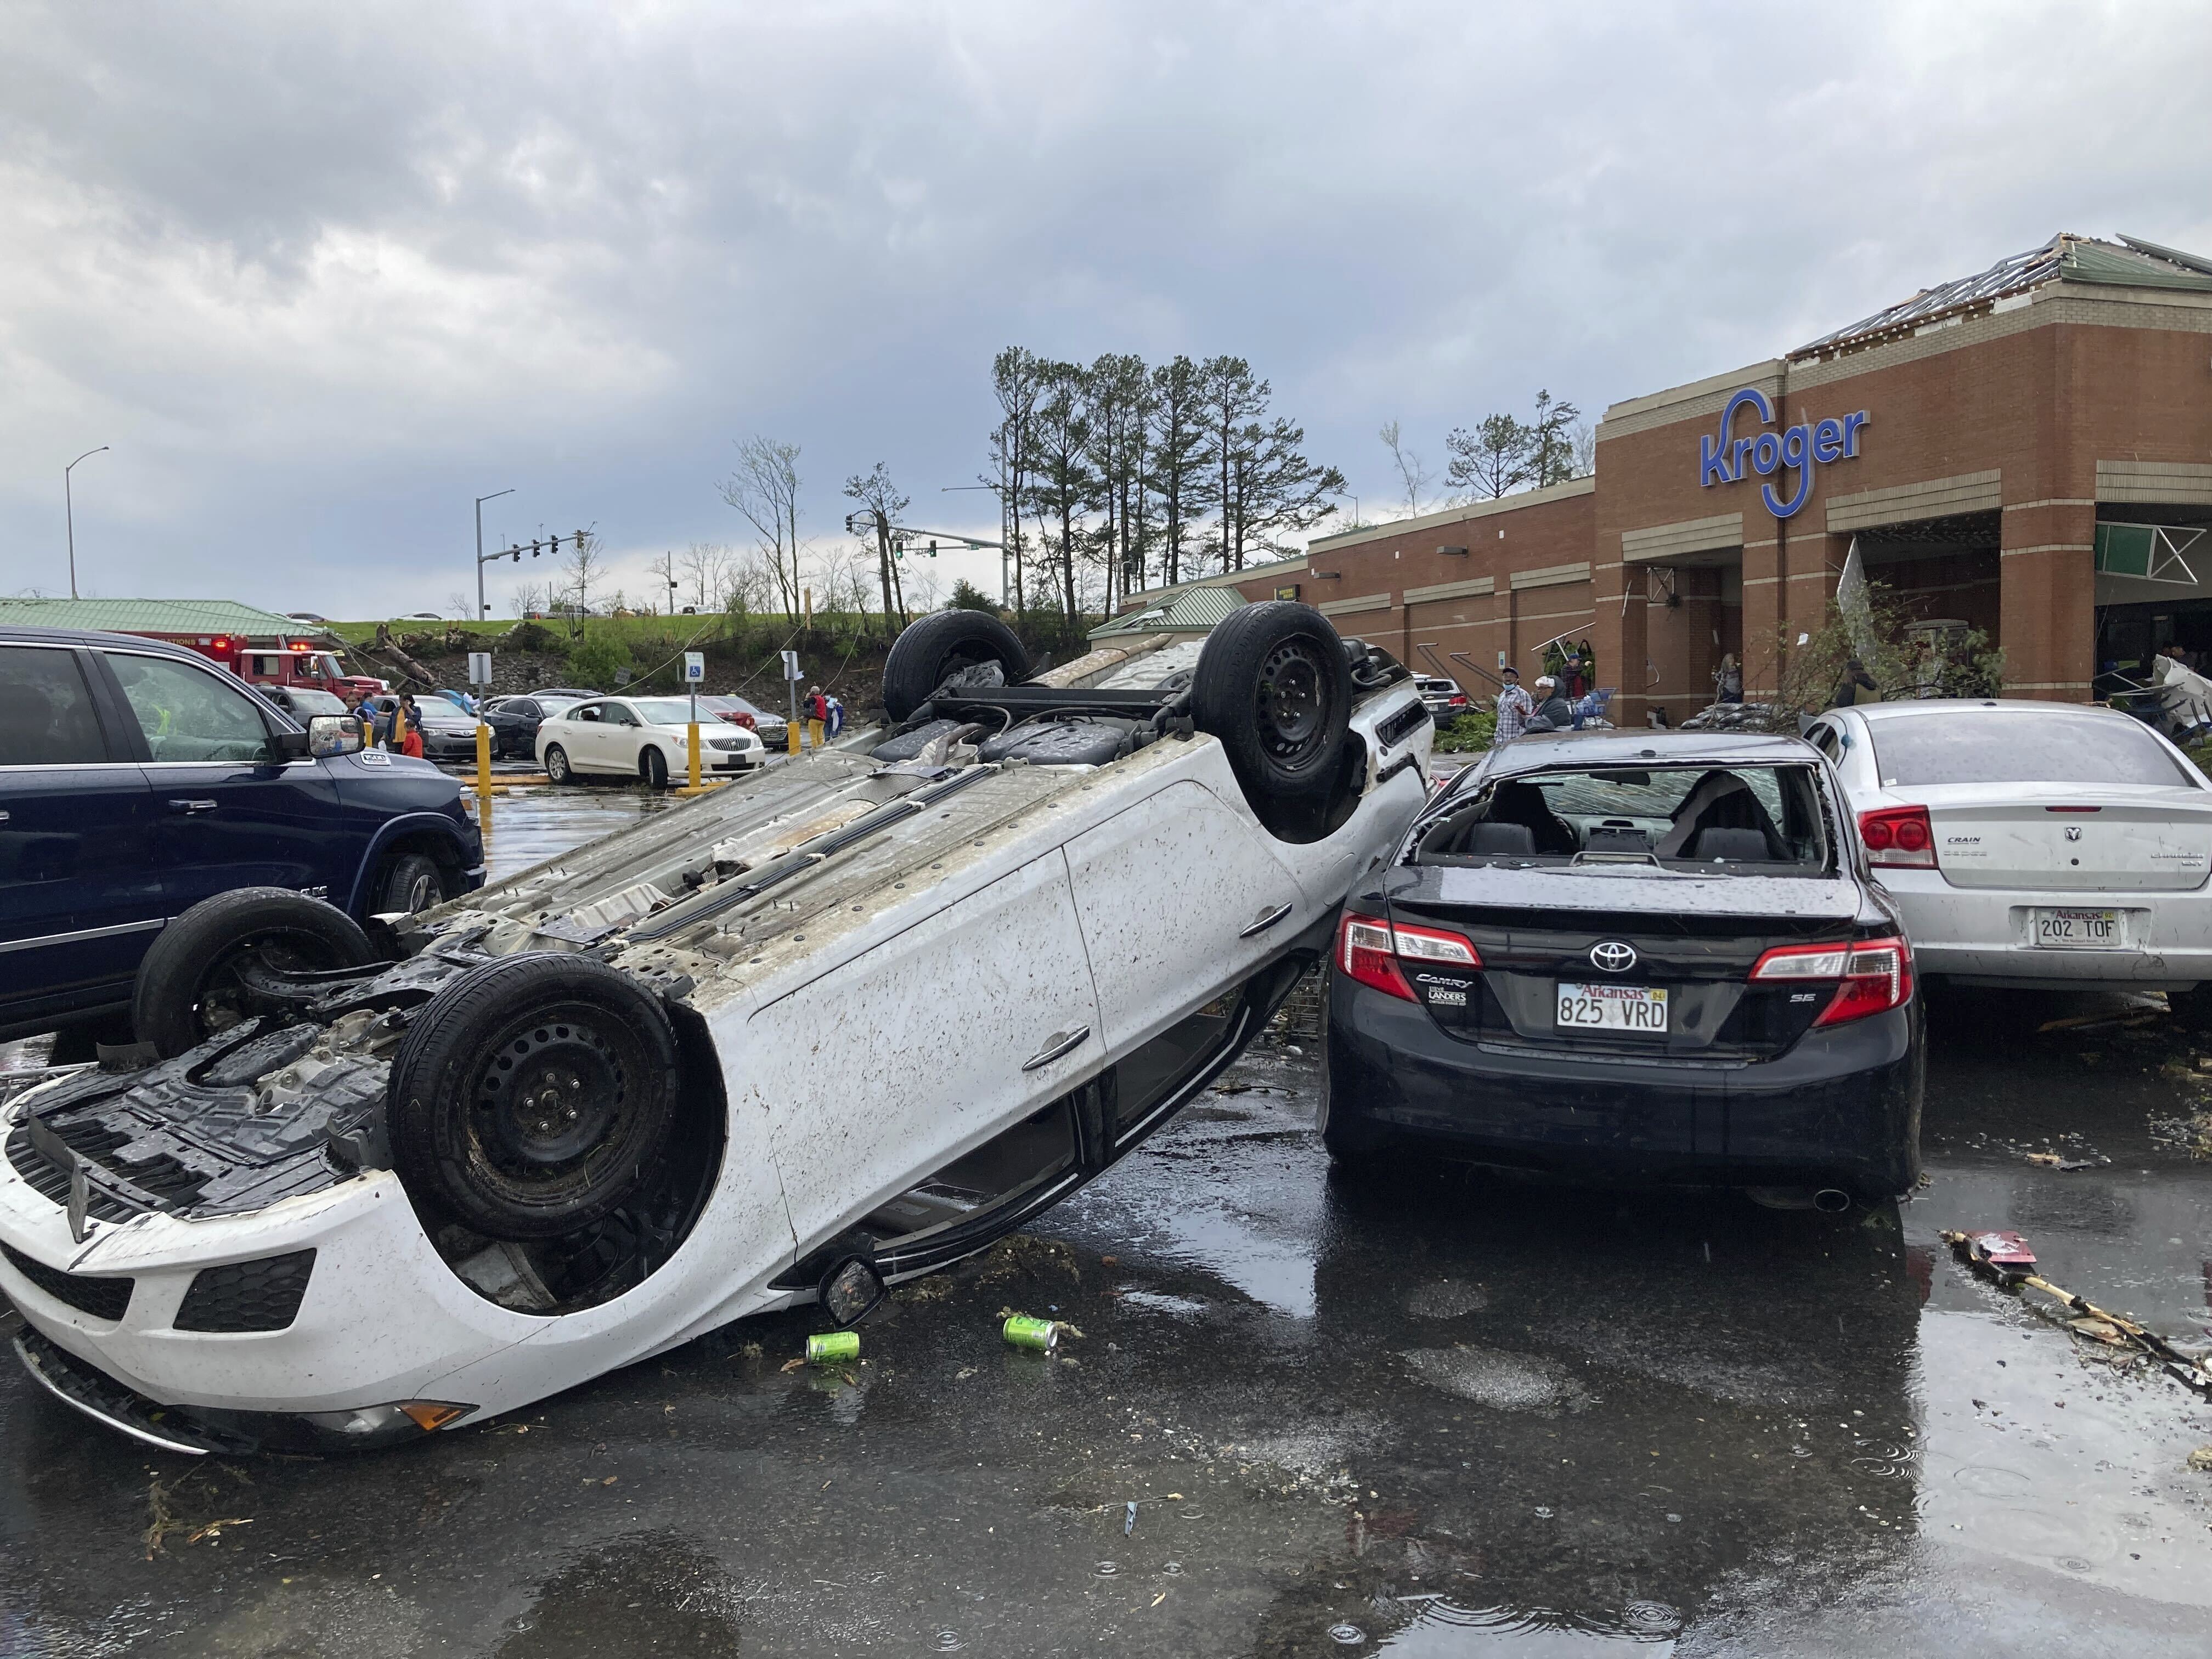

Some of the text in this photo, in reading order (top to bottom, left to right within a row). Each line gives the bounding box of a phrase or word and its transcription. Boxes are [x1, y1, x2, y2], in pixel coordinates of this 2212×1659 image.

[1701, 388, 1870, 517] Kroger
[2056, 909, 2103, 920] Arkansas
[2041, 919, 2115, 937] 202 TOF
[1428, 991, 1466, 1001] LANDERS
[1581, 984, 1645, 1000] Arkansas
[1790, 994, 1816, 1002] SE
[1560, 996, 1664, 1028] 825 VRD
